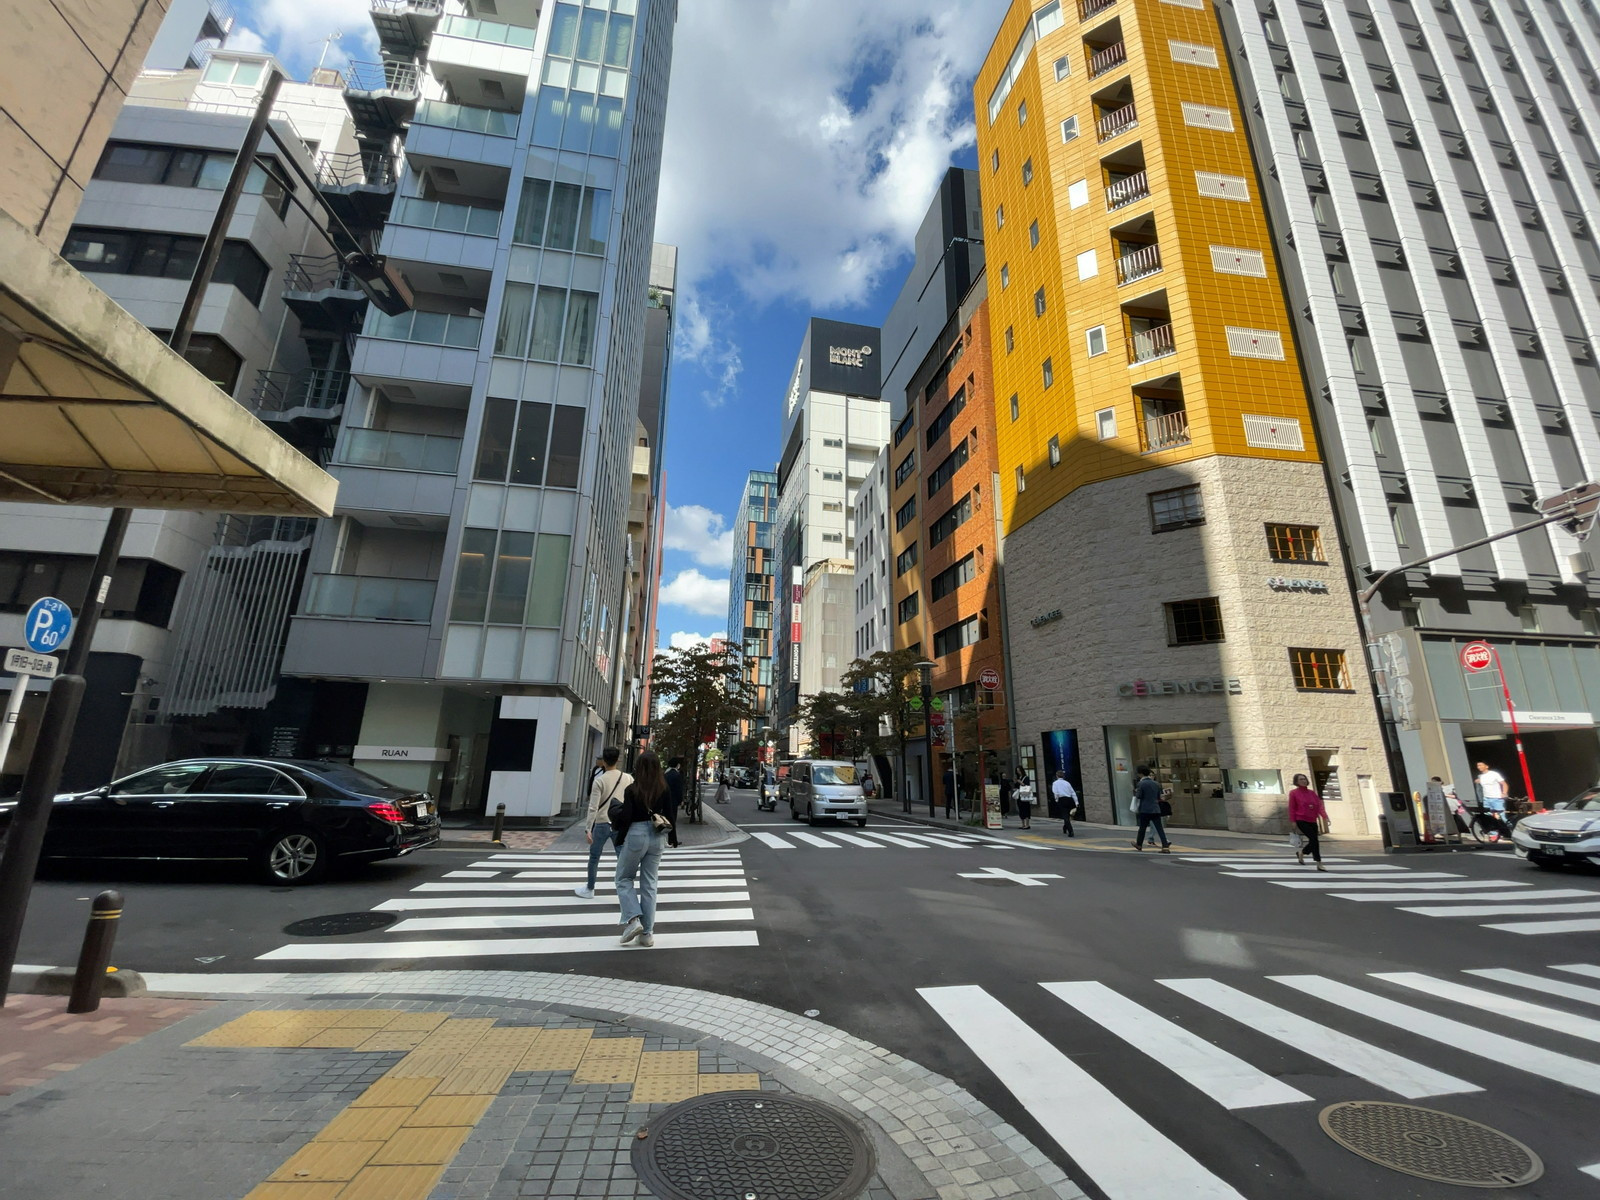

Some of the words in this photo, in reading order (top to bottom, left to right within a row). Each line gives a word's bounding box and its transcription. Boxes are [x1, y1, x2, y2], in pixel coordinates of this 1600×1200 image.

[830, 346, 861, 358] MONT
[830, 355, 863, 367] BLANC
[31, 608, 53, 641] P
[41, 630, 58, 646] 60
